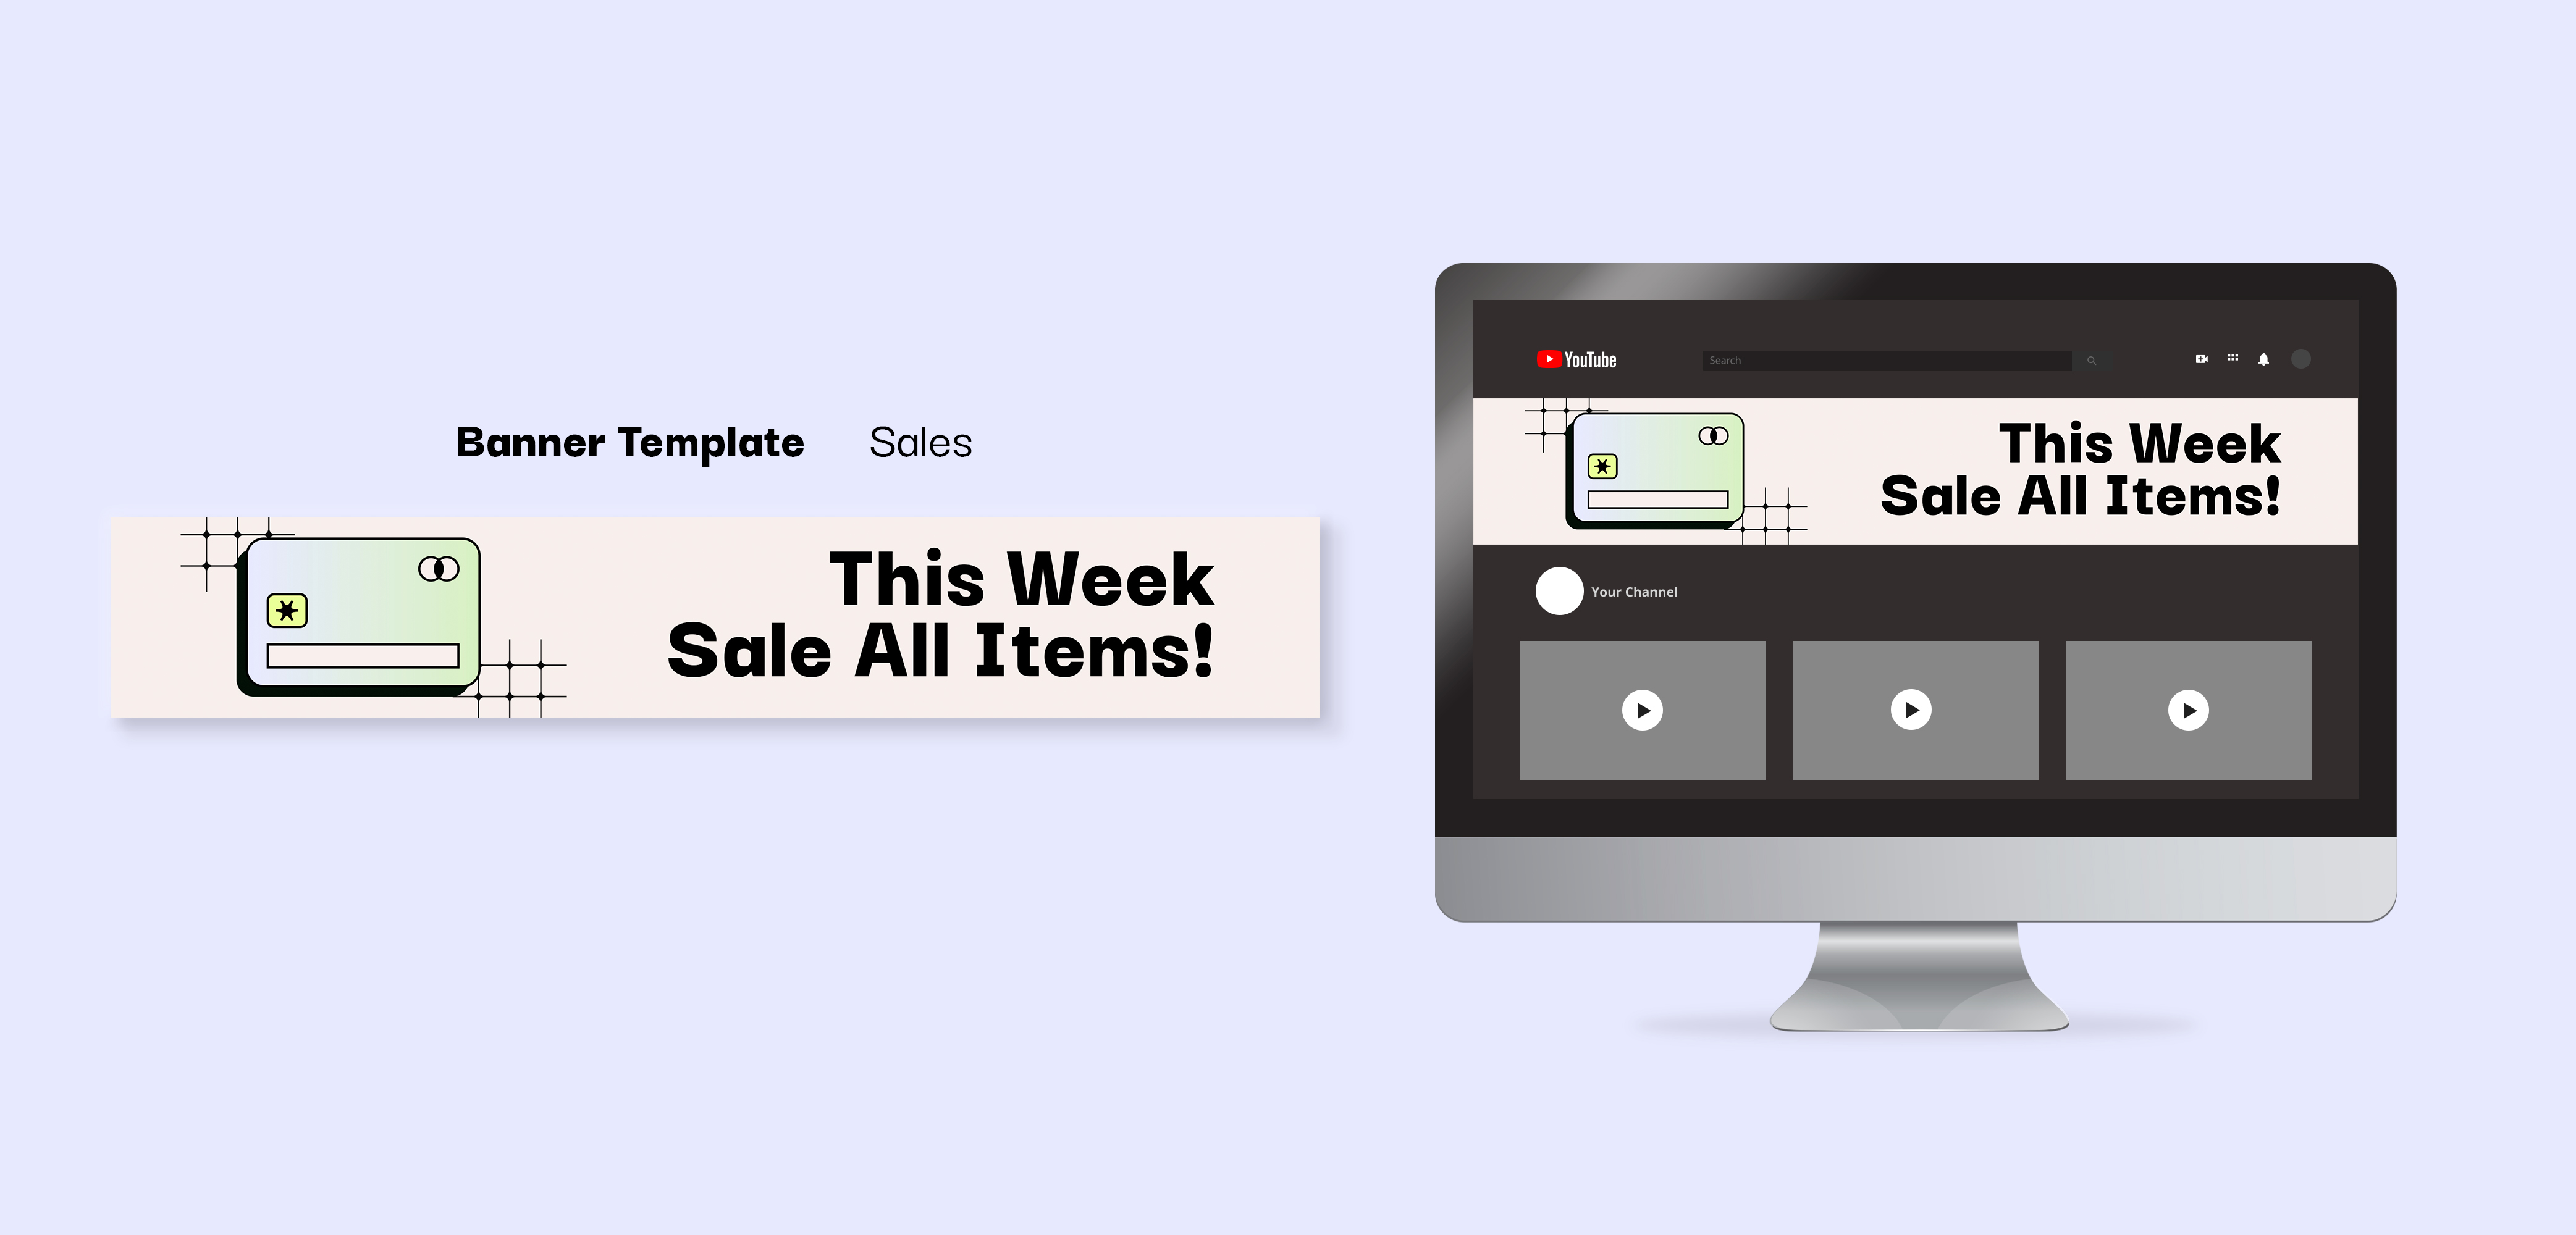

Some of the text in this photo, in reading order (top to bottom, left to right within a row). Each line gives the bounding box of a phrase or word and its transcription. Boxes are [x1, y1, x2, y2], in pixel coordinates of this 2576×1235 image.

[1565, 351, 1616, 368] YouTube
[1709, 355, 1741, 365] Search
[2000, 420, 2281, 463] This Week
[1882, 474, 2279, 516] Sale All Items!
[830, 548, 1215, 606] This Week
[1591, 587, 1678, 598] Your Channel
[668, 622, 1211, 677] Sale All Items!
